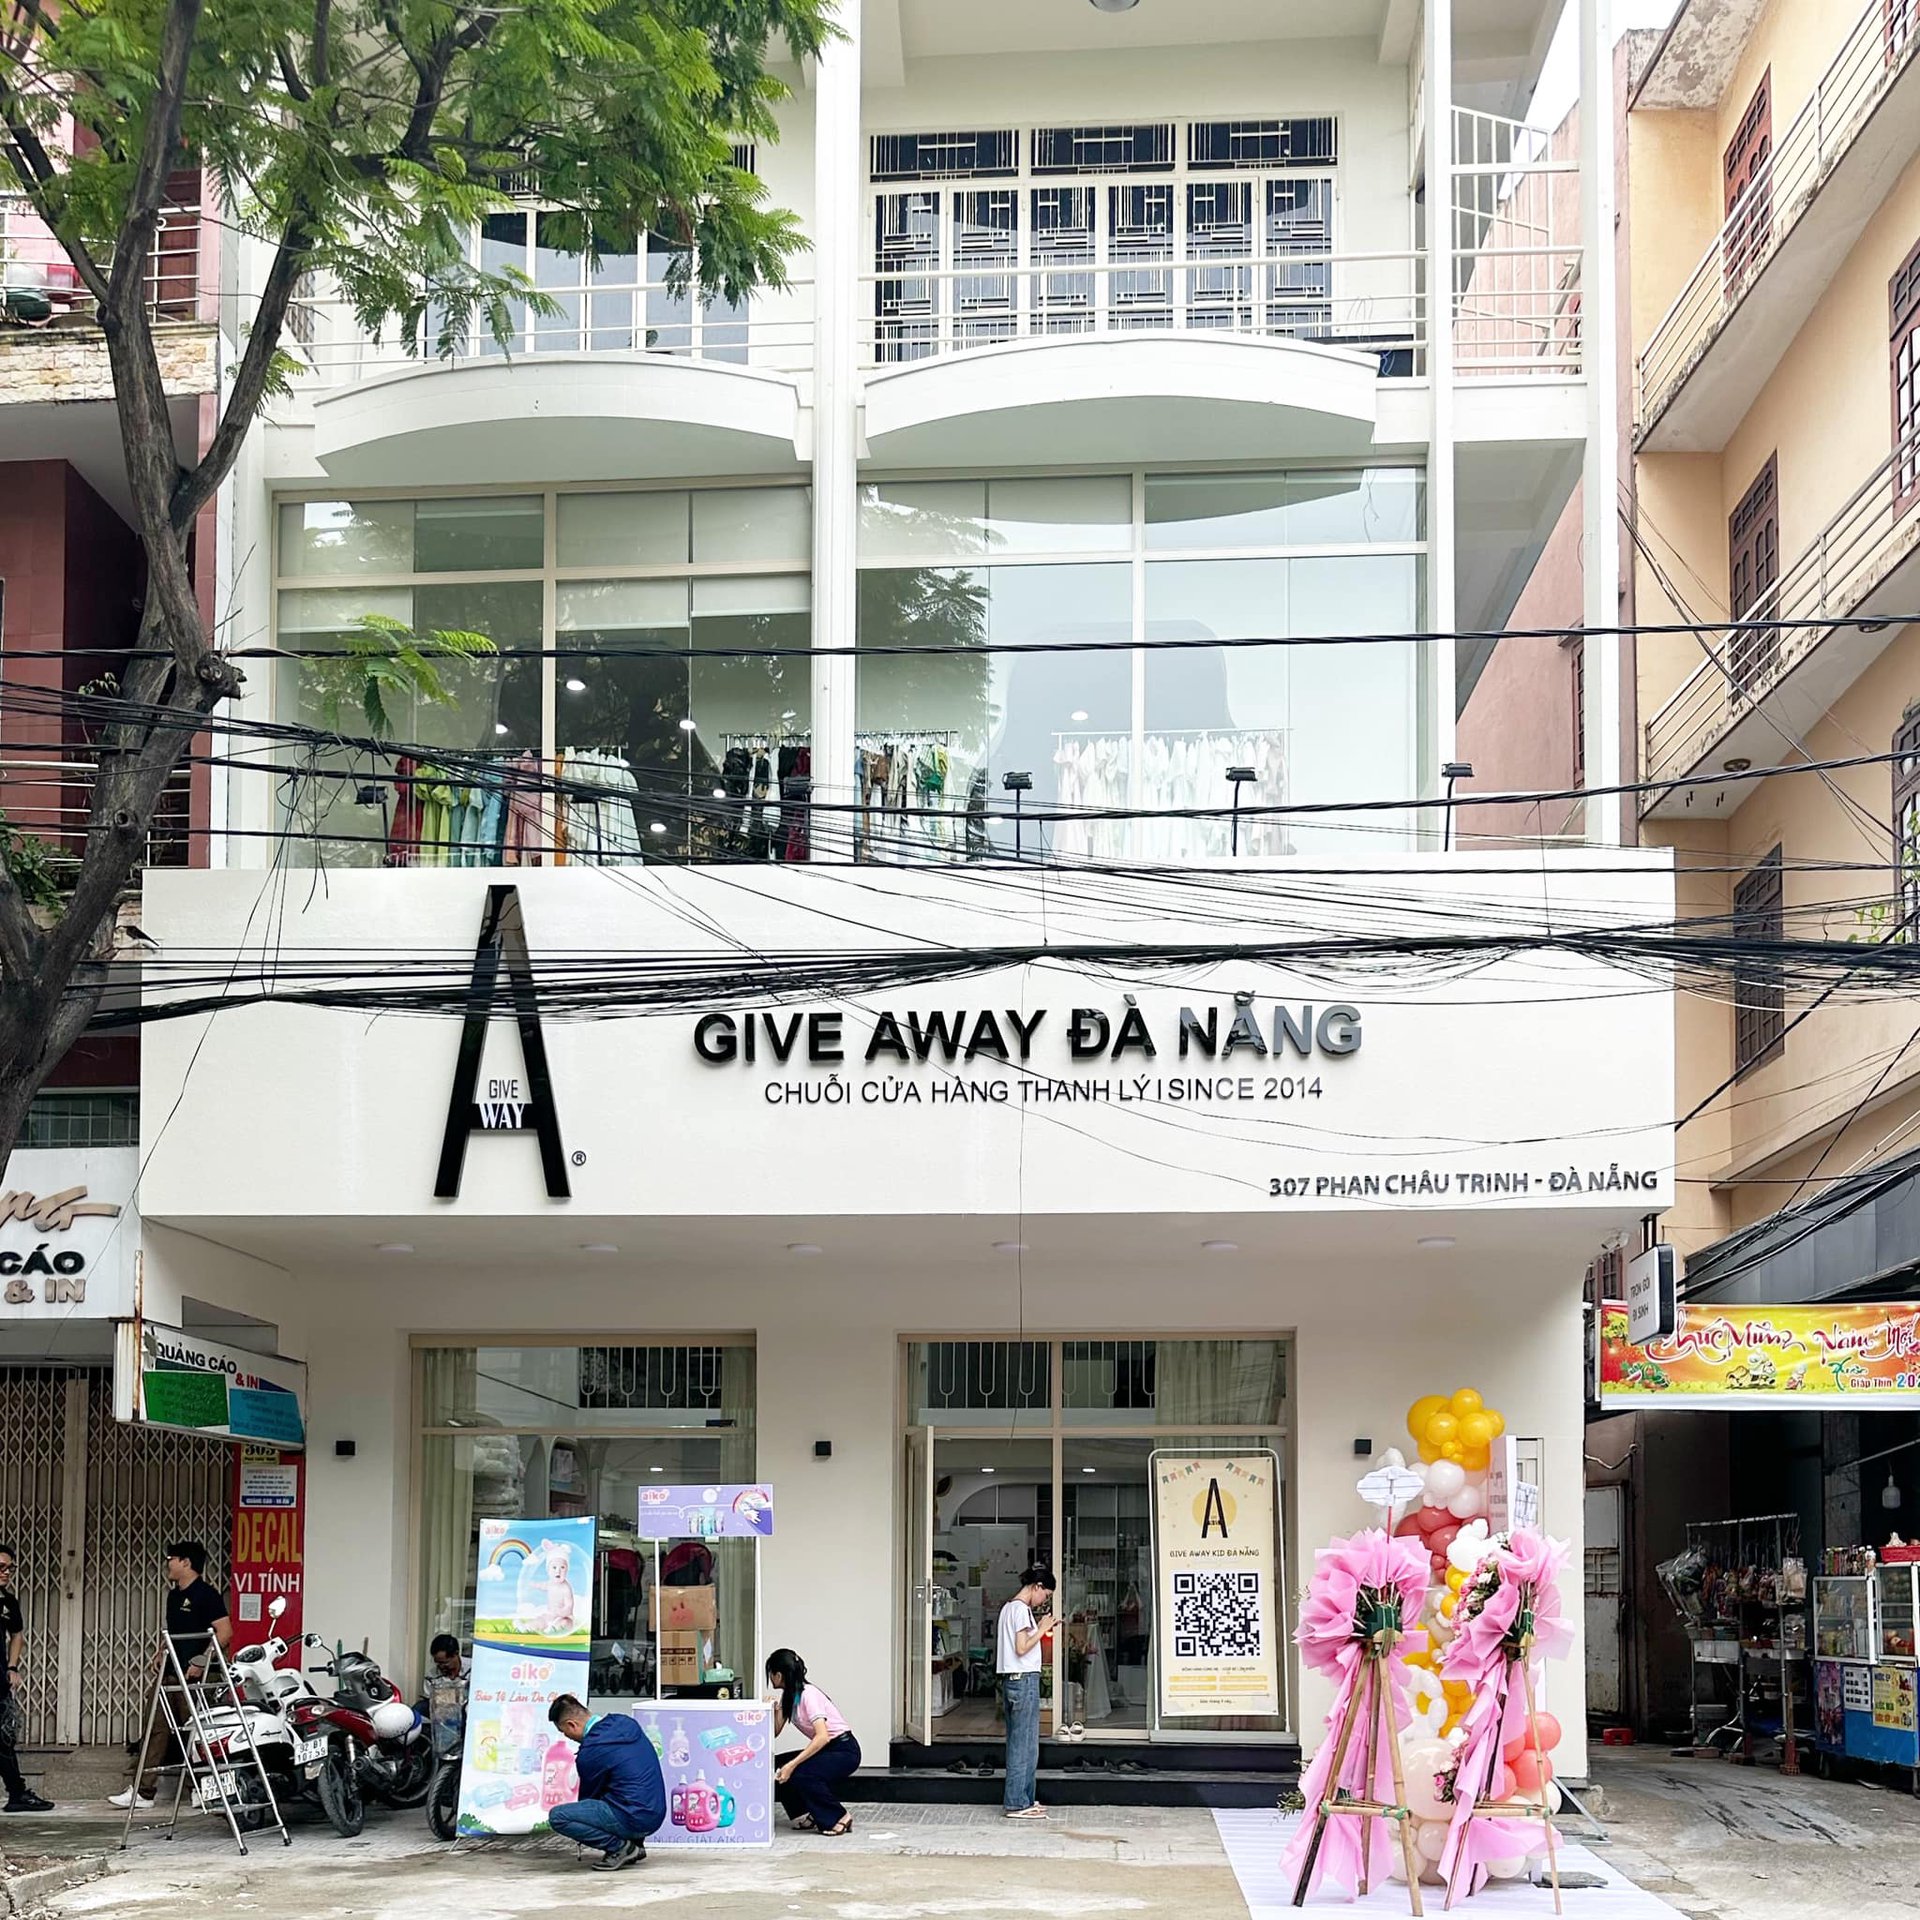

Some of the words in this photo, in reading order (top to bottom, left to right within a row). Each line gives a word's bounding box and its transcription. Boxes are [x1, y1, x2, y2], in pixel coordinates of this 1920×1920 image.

[693, 1012, 844, 1063] GIVE
[865, 1009, 1048, 1061] AWAY
[1067, 993, 1156, 1058] ĐÀ
[489, 1079, 518, 1099] GIVE
[765, 1073, 851, 1104] CHUỖI
[862, 1075, 921, 1103] CỬA
[932, 1075, 1008, 1103] HÀNG
[1018, 1078, 1109, 1103] THANH
[1119, 1073, 1151, 1101] LÝ
[1168, 1077, 1254, 1100] SINCE
[1264, 1076, 1323, 1100] 2014
[479, 1102, 526, 1129] WAY
[1269, 1177, 1310, 1197] 307
[1316, 1175, 1380, 1196] PHAN
[1385, 1169, 1449, 1195] CHÂU
[1455, 1172, 1529, 1194] TRINH
[1549, 1166, 1582, 1191] ĐÀ
[1589, 1162, 1657, 1190] NẴNG
[0, 1243, 85, 1275] CÁO
[4, 1280, 35, 1304] &
[45, 1278, 86, 1304] IN
[208, 1354, 237, 1374] CÁO
[235, 1372, 245, 1387] &
[246, 1374, 259, 1389] IN
[642, 1490, 667, 1501] aiko
[1201, 1477, 1228, 1539] A
[236, 1512, 302, 1563] DECAL
[1212, 1549, 1225, 1557] KID
[233, 1572, 252, 1593] VI
[258, 1567, 300, 1593] TÍNH
[511, 1664, 550, 1680] aiko
[736, 1712, 762, 1722] aiko
